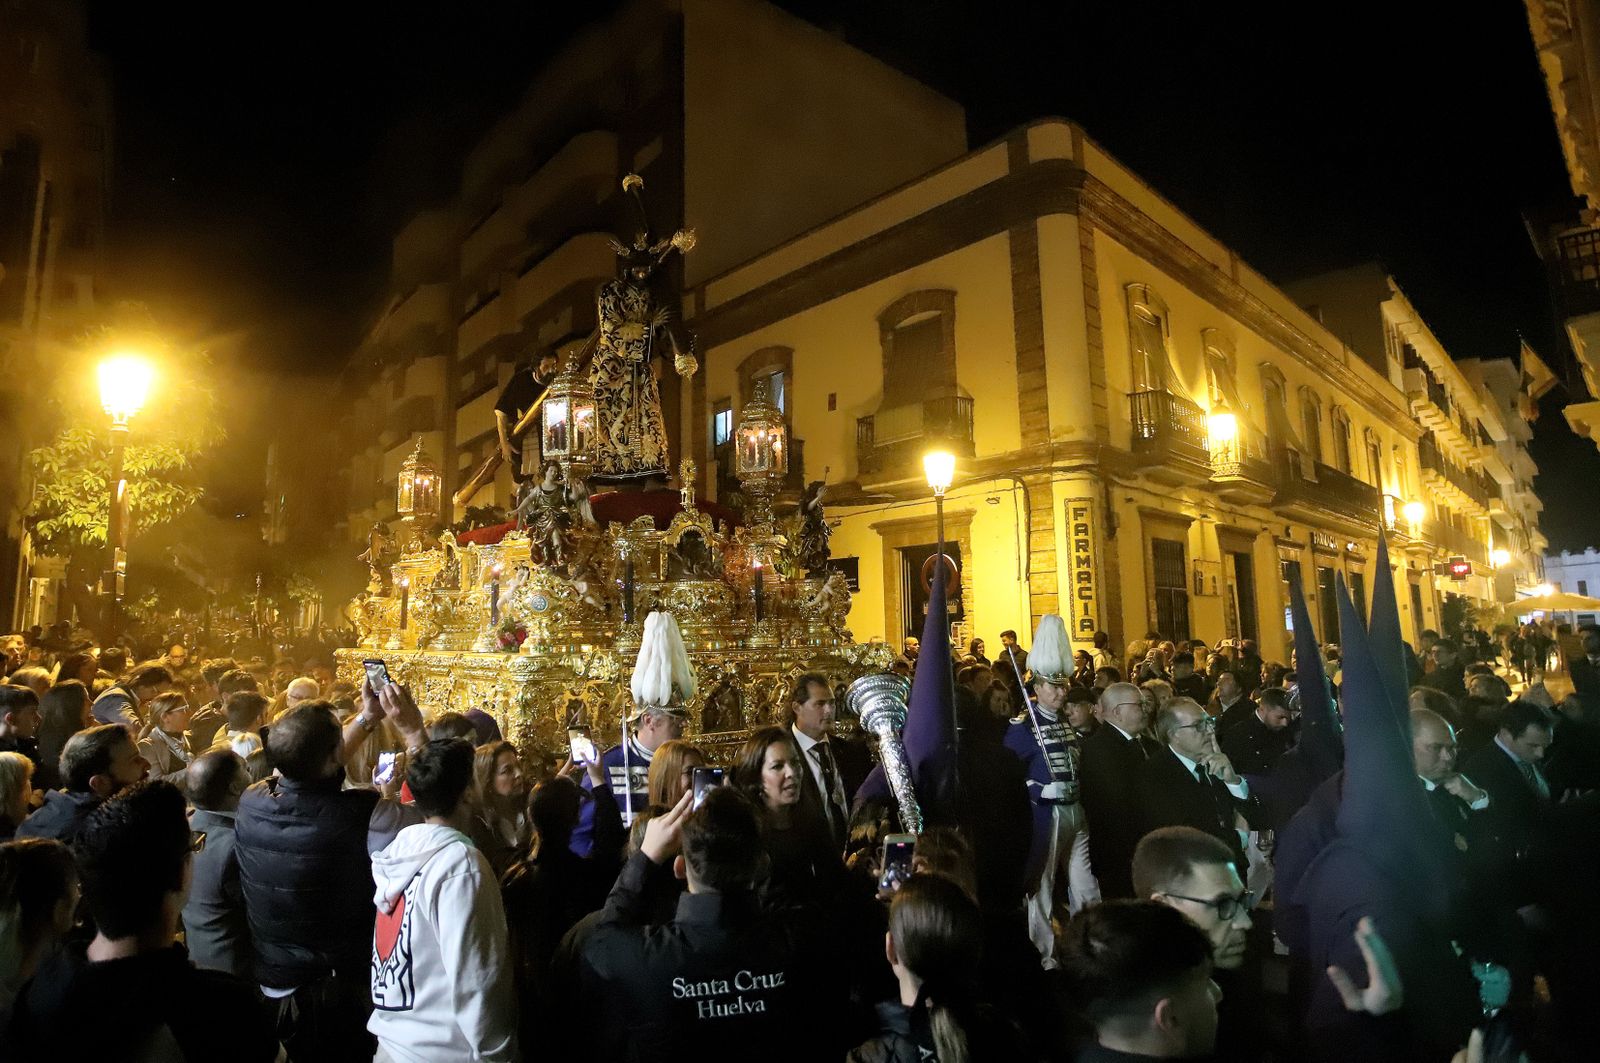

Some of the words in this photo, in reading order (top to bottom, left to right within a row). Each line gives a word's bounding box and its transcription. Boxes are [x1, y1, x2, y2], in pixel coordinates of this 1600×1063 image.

[1073, 507, 1094, 632] FARMACIA
[672, 977, 730, 999] Santa
[734, 969, 785, 991] Cruz
[697, 995, 766, 1019] Huelva
